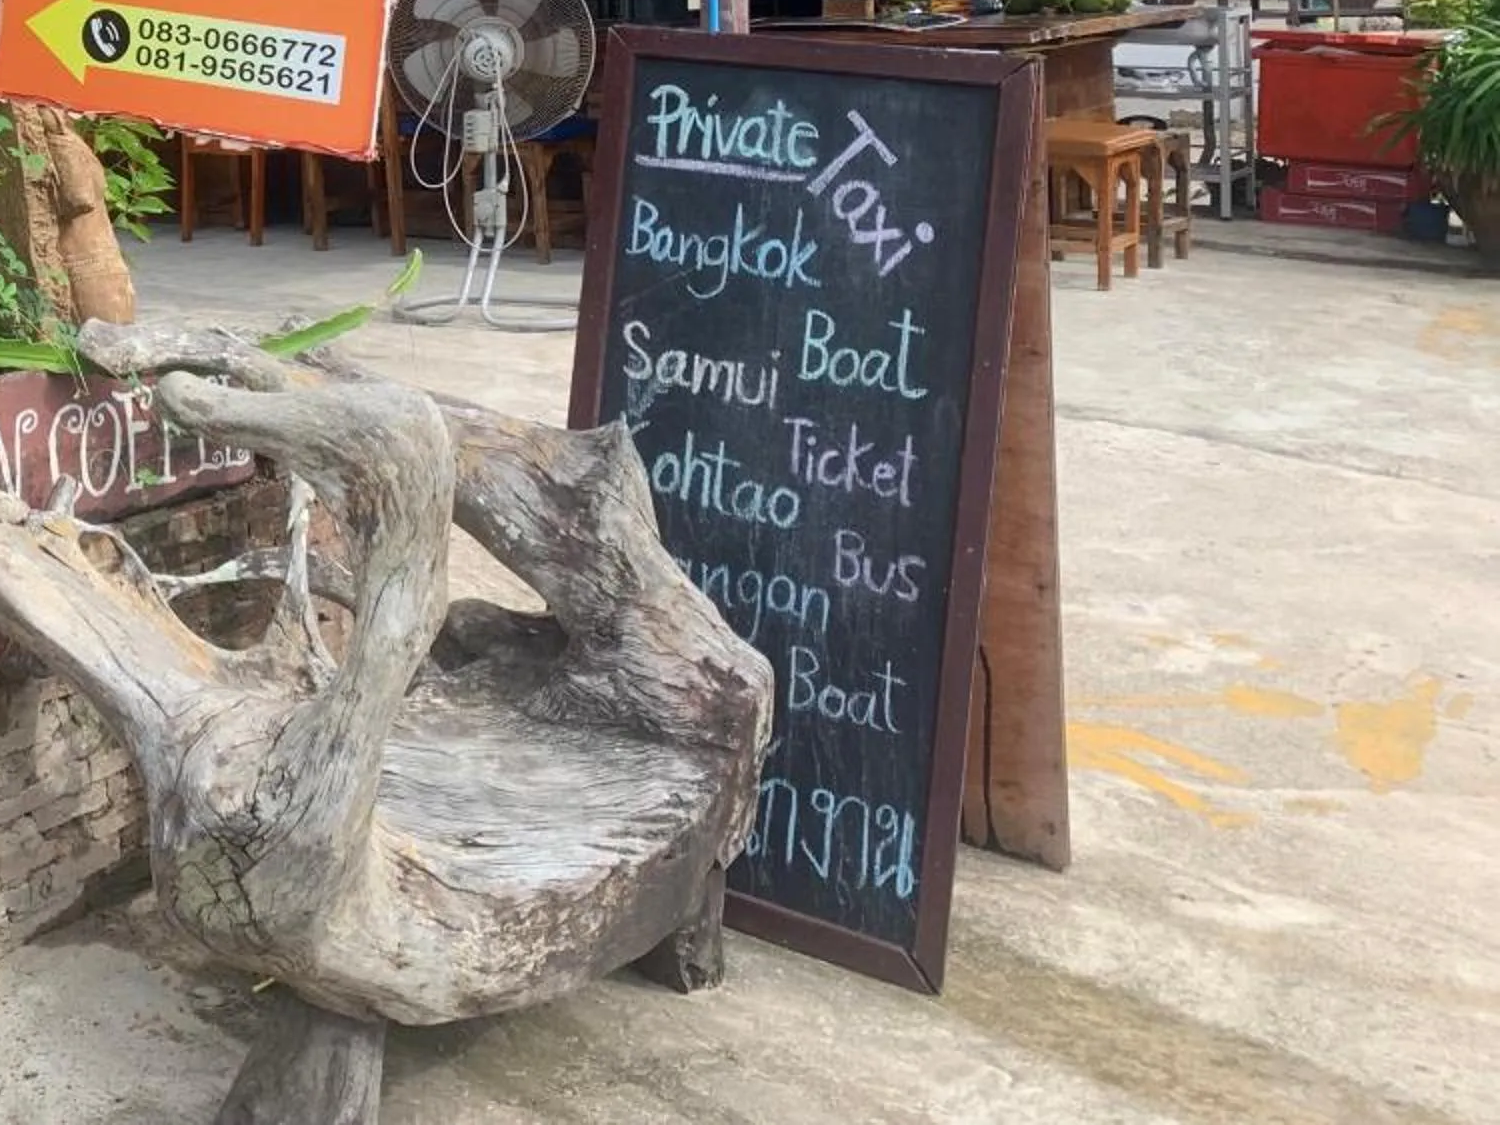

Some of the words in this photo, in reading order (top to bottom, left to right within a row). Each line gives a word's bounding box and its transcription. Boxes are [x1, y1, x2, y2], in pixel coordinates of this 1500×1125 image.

[135, 45, 331, 95] 081-9565621
[138, 18, 337, 68] 083-0666772
[647, 84, 820, 167] Private
[806, 108, 935, 276] Taxi
[626, 194, 821, 299] Bangkok
[622, 321, 781, 409] Samui
[798, 309, 928, 398] Boat
[632, 420, 800, 529] ohtao
[783, 417, 919, 506] Ticket
[835, 530, 926, 602] Bus
[788, 646, 905, 734] Boat
